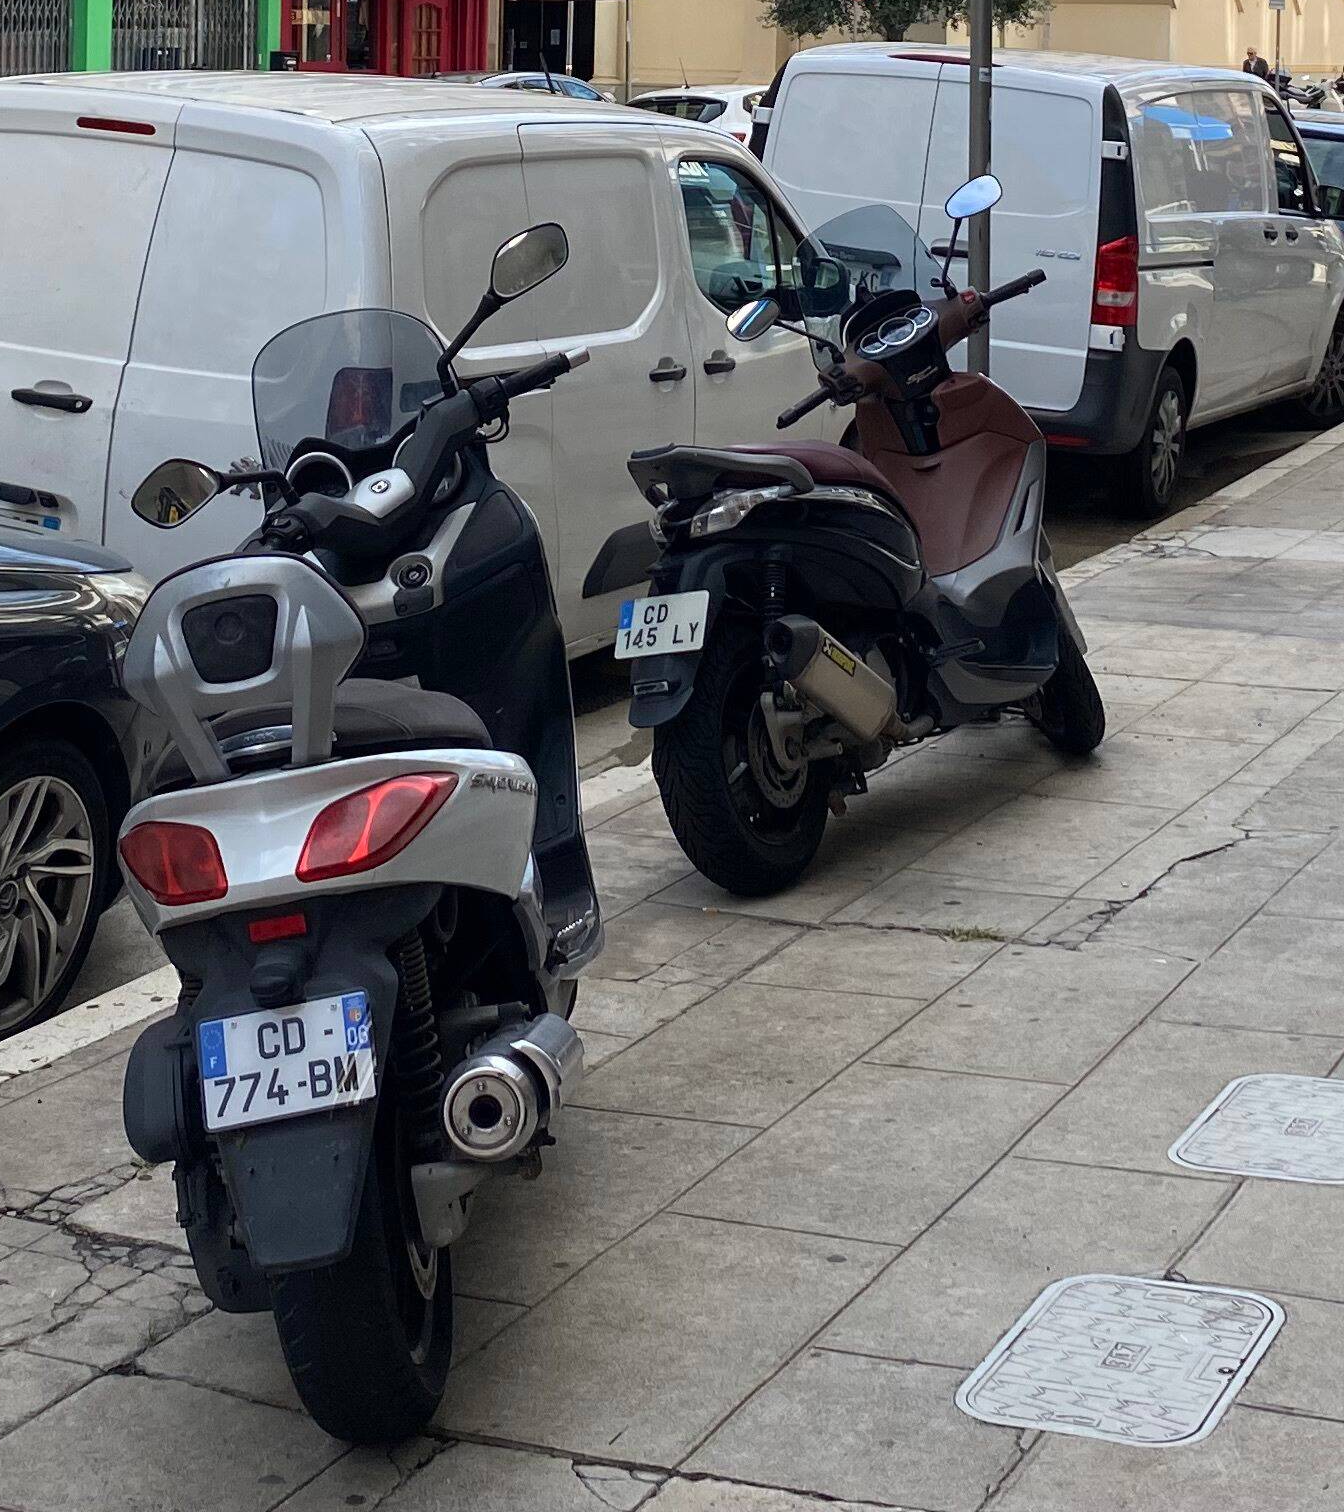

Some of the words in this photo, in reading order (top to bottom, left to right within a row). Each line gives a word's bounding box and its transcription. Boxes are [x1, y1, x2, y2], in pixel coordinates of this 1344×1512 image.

[643, 603, 669, 625] CD
[624, 626, 657, 650] 145
[672, 622, 699, 645] LY
[257, 1016, 306, 1059] CD
[209, 1056, 217, 1069] F
